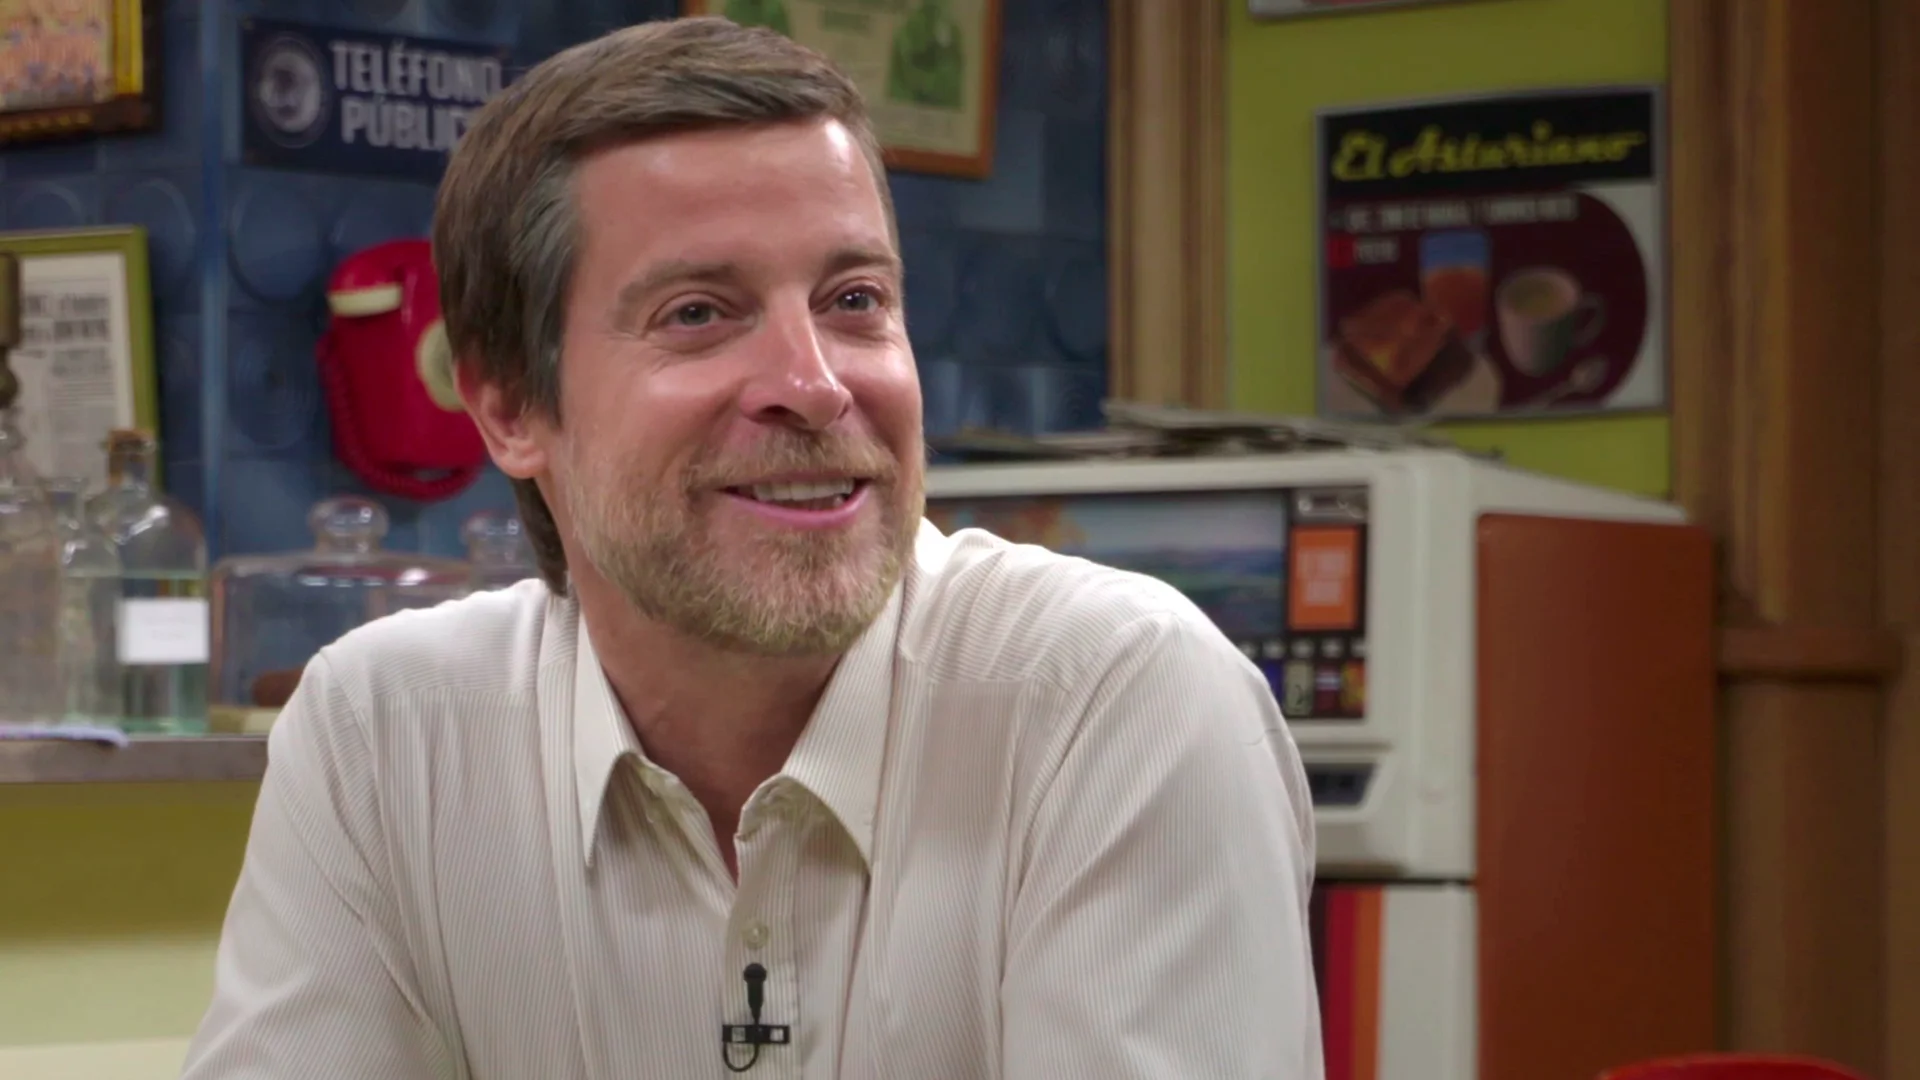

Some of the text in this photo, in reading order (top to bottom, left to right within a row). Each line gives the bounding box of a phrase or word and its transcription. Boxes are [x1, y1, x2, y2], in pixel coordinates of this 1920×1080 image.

[339, 94, 476, 151] PÚBLIC
[1331, 119, 1647, 182] El Asturiano
